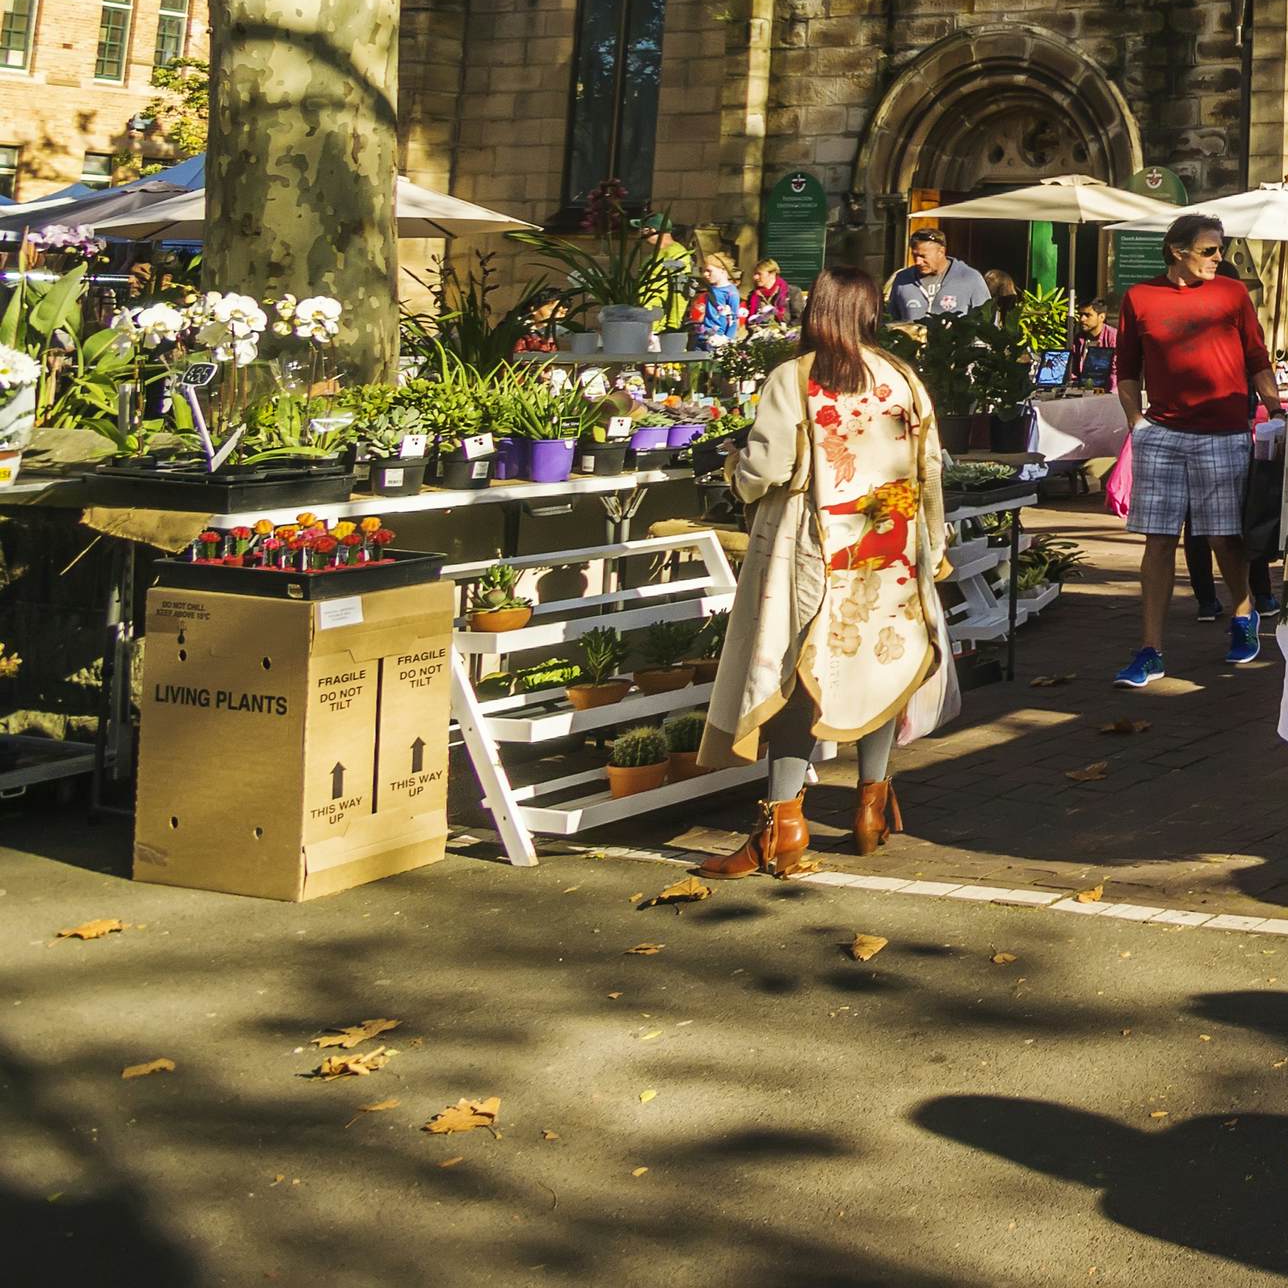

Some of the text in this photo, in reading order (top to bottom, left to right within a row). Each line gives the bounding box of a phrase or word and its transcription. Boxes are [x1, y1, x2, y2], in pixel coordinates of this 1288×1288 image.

[397, 648, 447, 666] FRAGILE
[317, 669, 367, 688] FRAGILE
[400, 663, 444, 681] DO NOT
[409, 676, 433, 689] TILT
[155, 684, 288, 716] LIVING PLANTS
[320, 685, 364, 704] DO NOT
[329, 698, 353, 712] TILT
[389, 769, 443, 792] THIS WAY
[408, 786, 425, 798] UP
[310, 796, 363, 819] THIS WAY
[328, 812, 345, 825] UP
